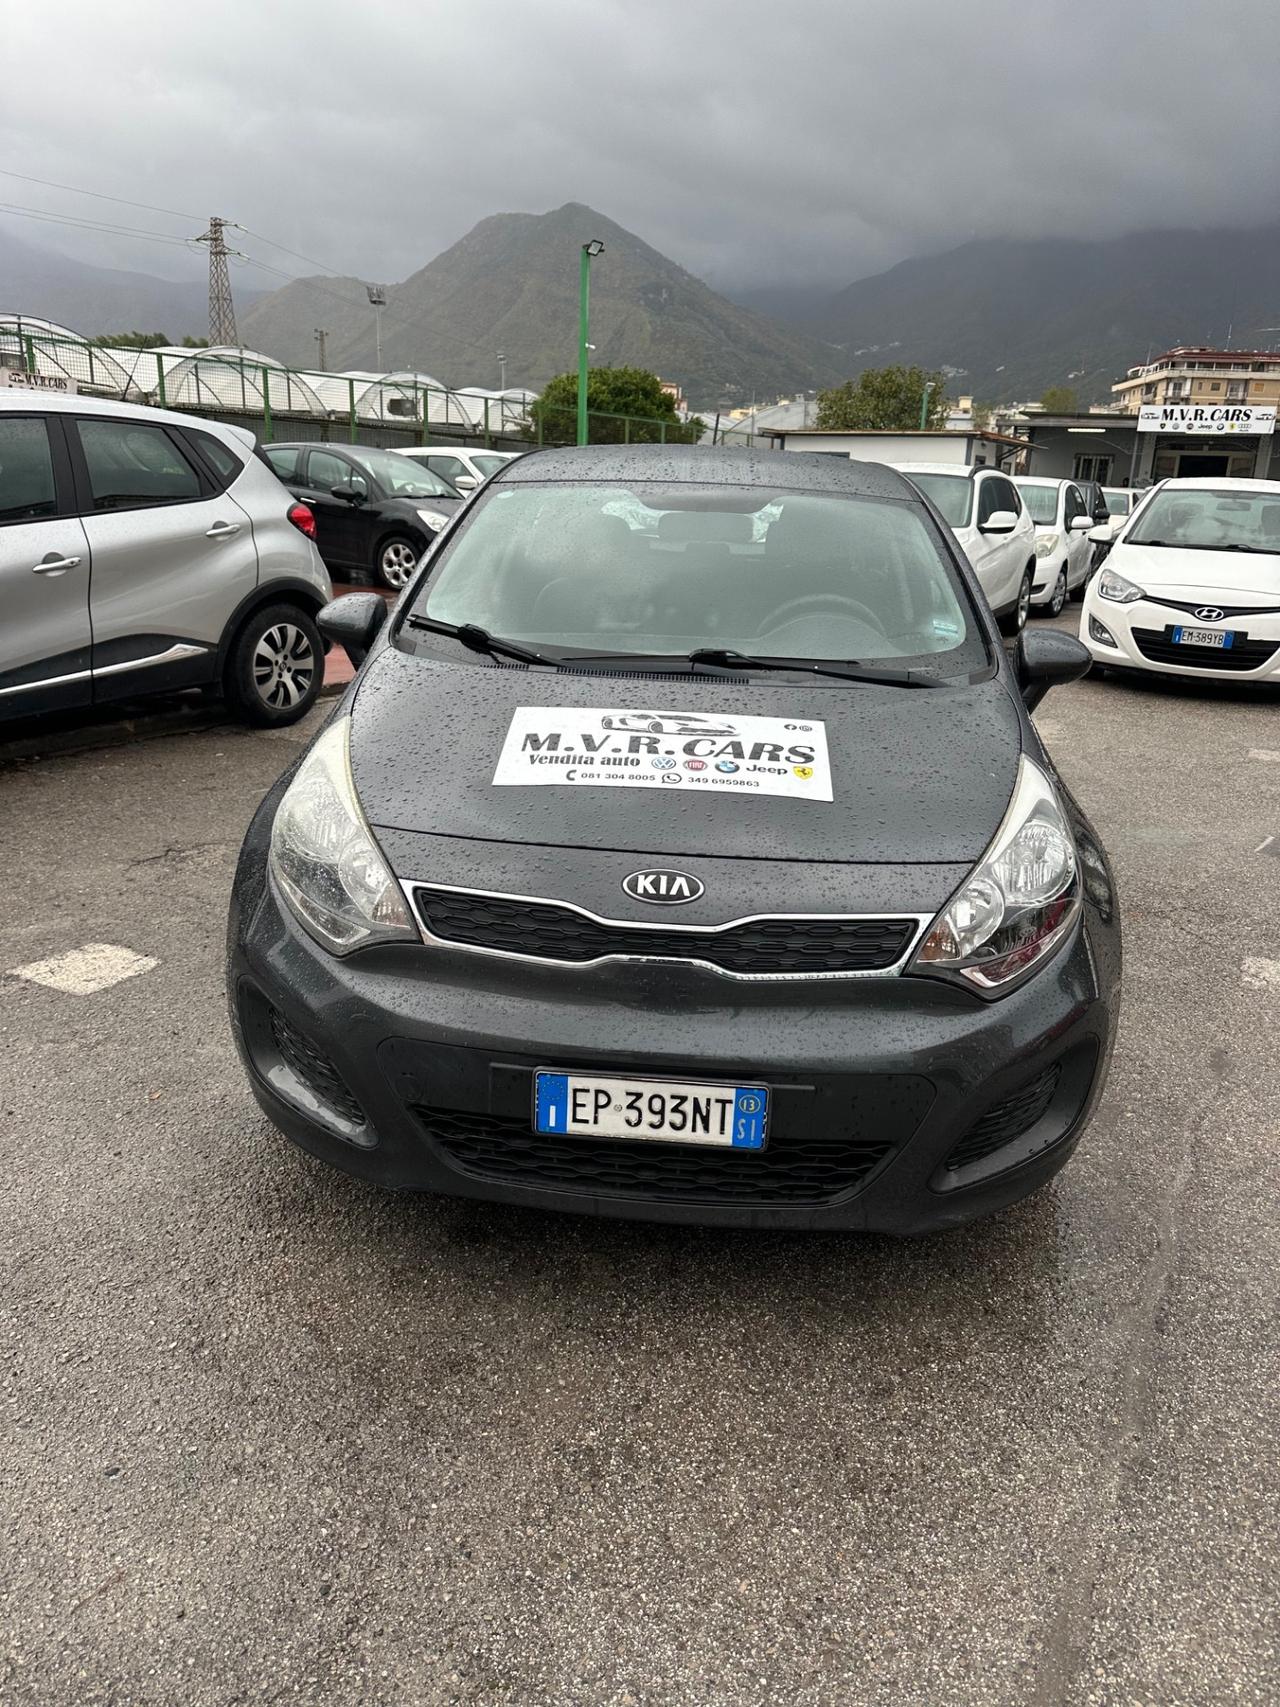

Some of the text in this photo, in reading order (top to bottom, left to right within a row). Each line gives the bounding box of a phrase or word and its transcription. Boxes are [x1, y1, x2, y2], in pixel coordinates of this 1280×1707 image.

[529, 753, 595, 766] Vendita
[600, 755, 641, 767] auto
[746, 764, 788, 776] Jeep
[688, 776, 709, 784] 349
[711, 777, 760, 788] 6959863
[637, 874, 691, 897] KIA
[743, 1099, 755, 1111] 13
